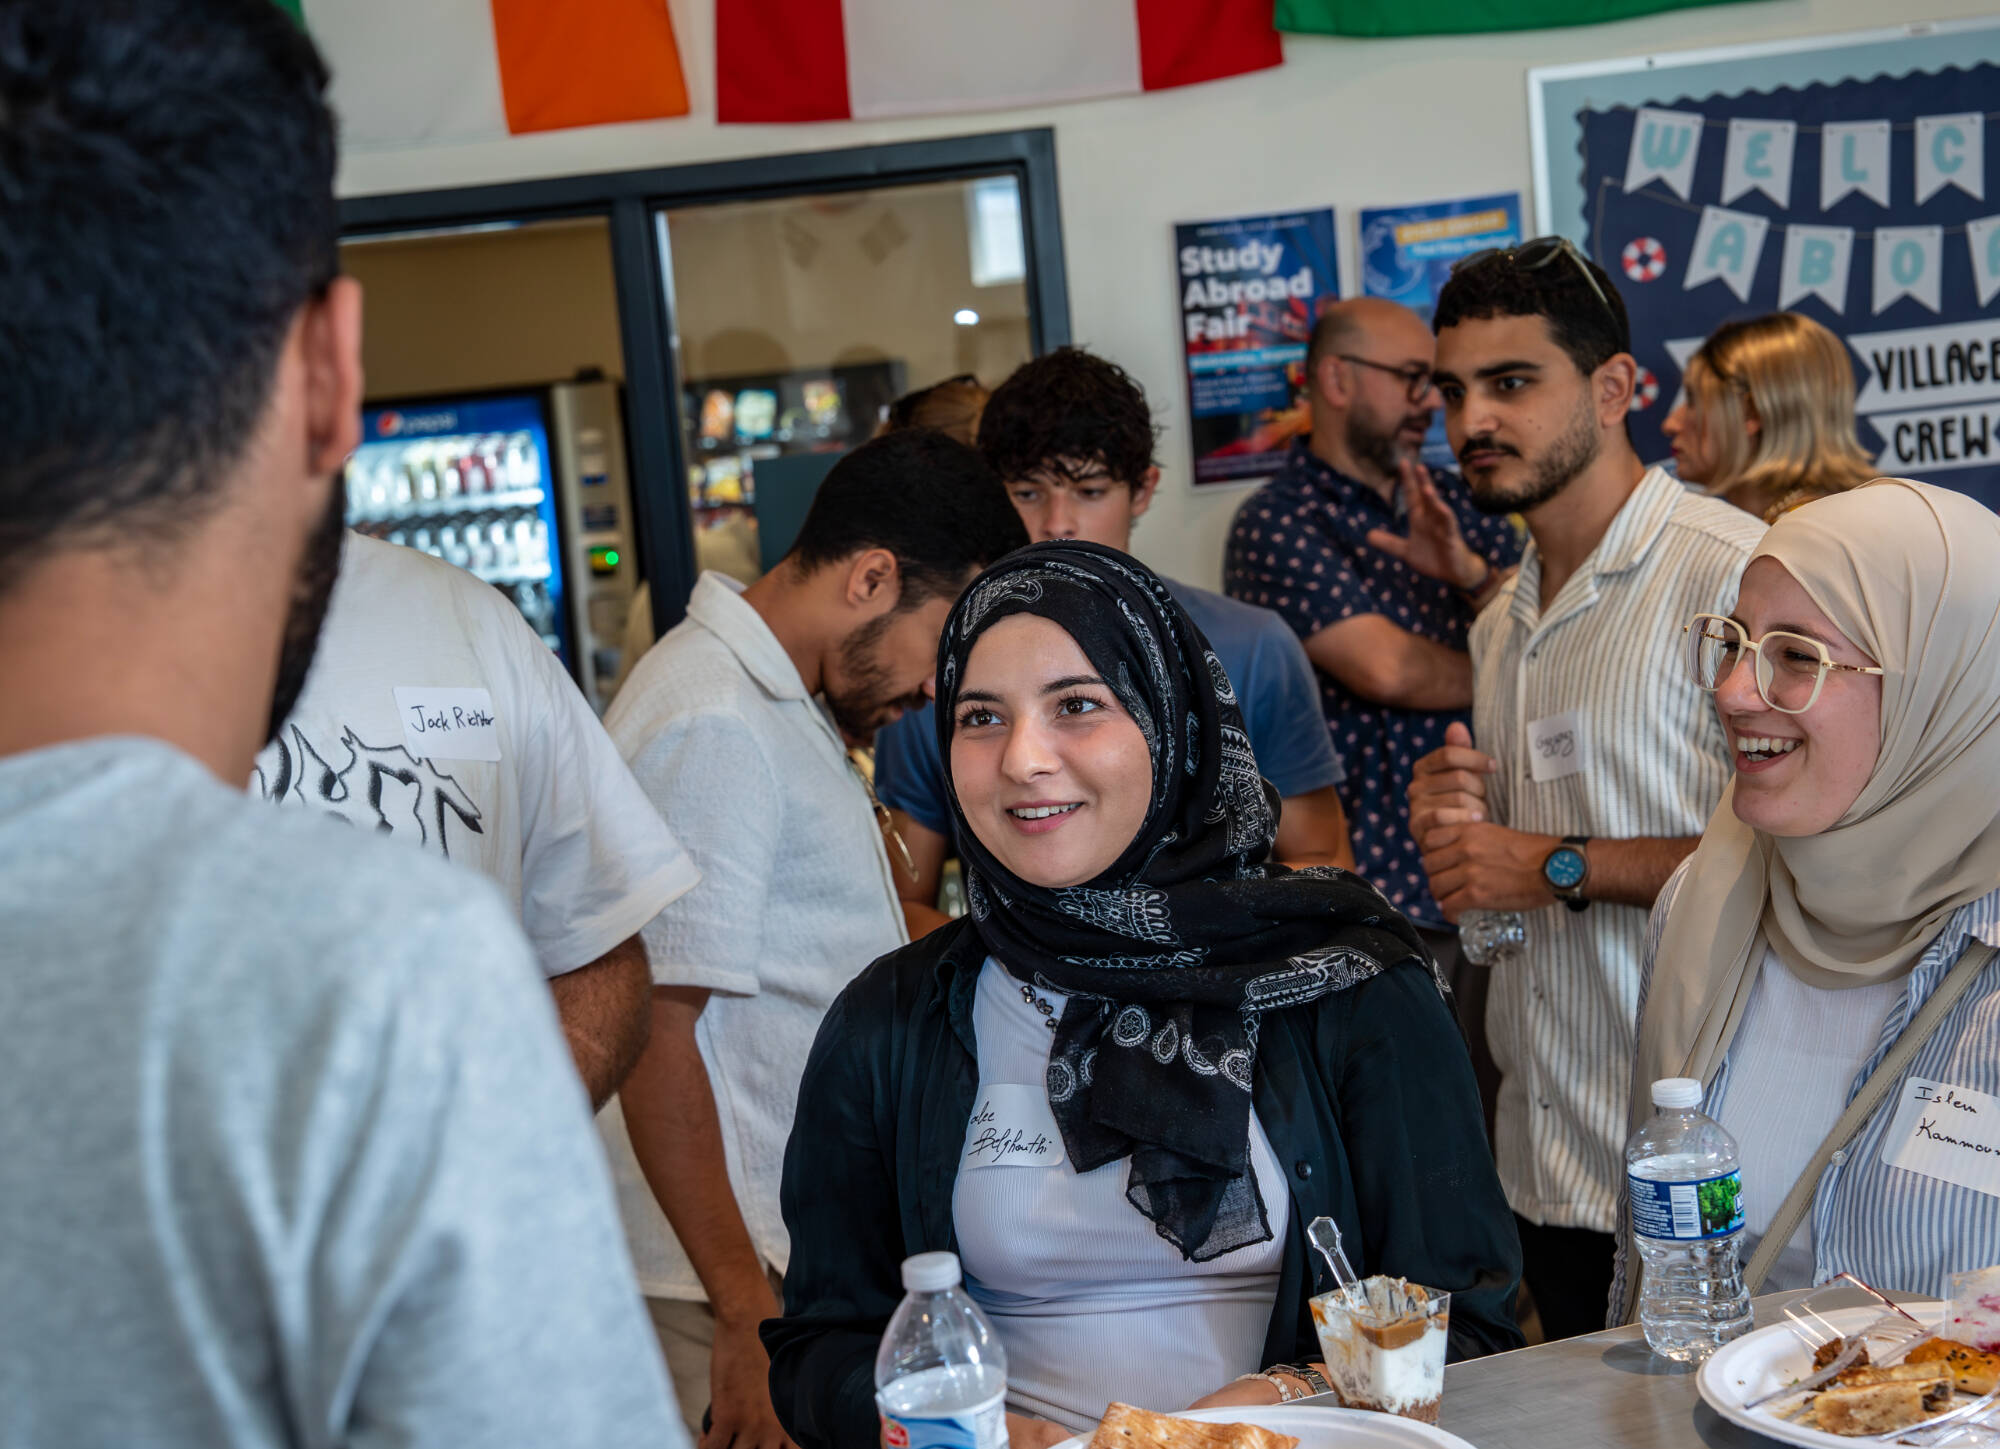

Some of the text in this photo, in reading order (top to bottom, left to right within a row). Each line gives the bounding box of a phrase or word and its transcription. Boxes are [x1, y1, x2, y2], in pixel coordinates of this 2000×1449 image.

[1180, 239, 1284, 276] Study
[1184, 266, 1314, 308] Abroad
[1186, 306, 1250, 342] Fair
[1872, 337, 2000, 392] VILLAGE
[1894, 414, 1990, 464] CREW
[411, 705, 451, 733] Jack
